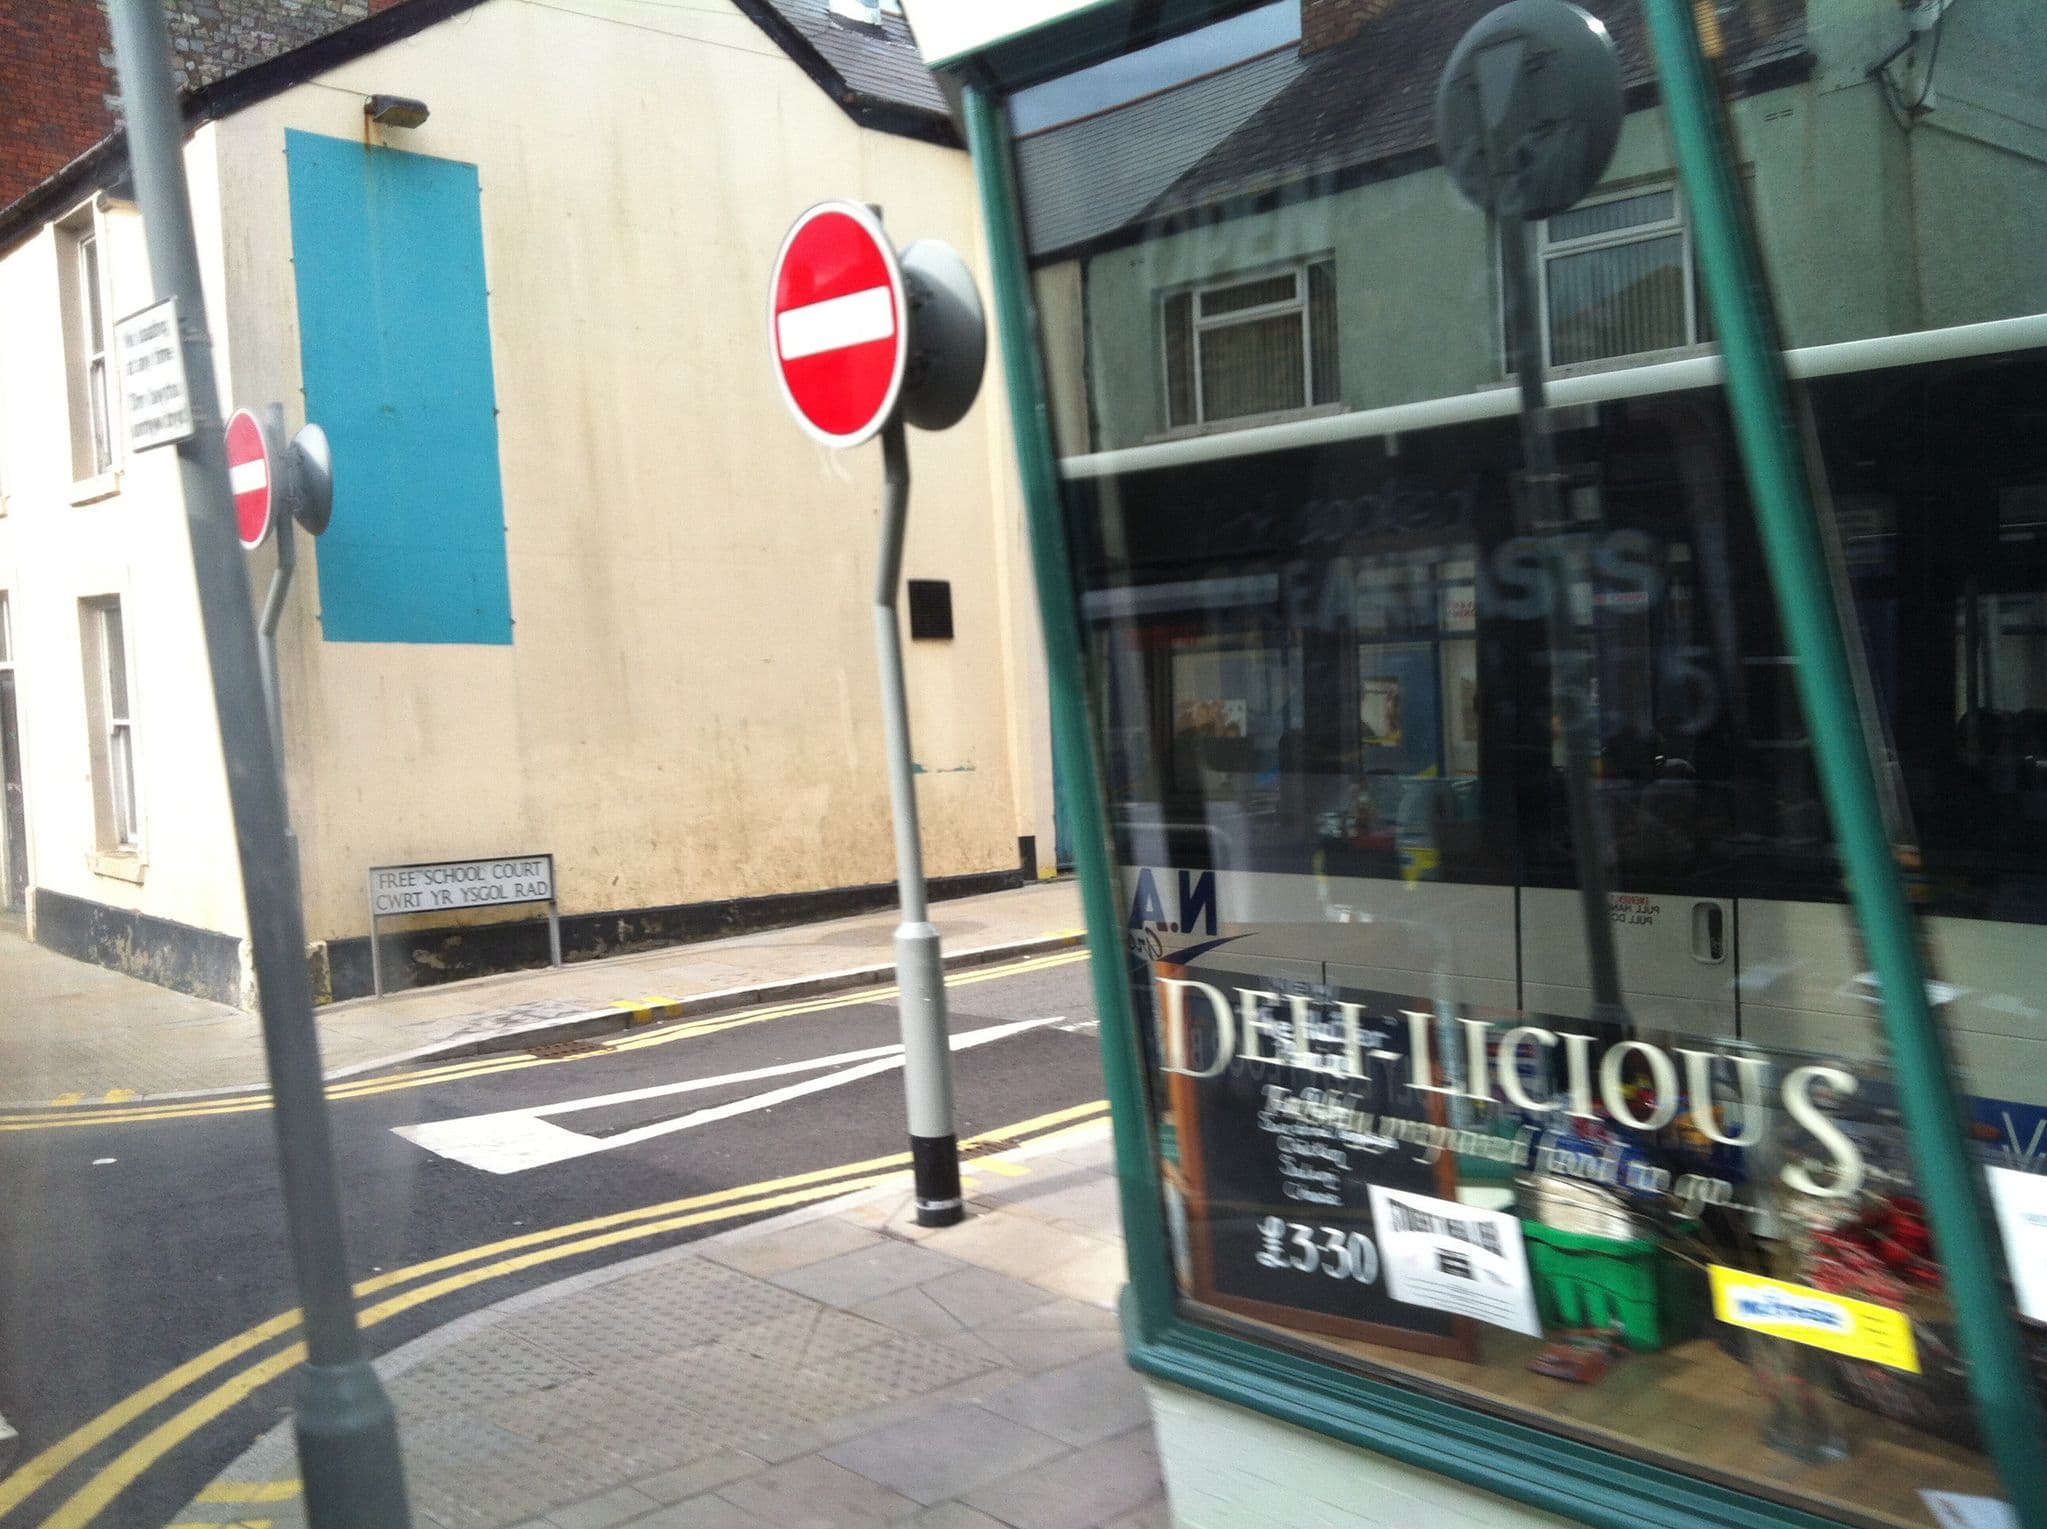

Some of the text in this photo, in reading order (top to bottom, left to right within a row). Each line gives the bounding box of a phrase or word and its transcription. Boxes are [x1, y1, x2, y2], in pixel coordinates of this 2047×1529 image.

[378, 861, 542, 890] FREE SCHOOL COURT
[376, 881, 548, 911] CWRT YR YSGOL RAD
